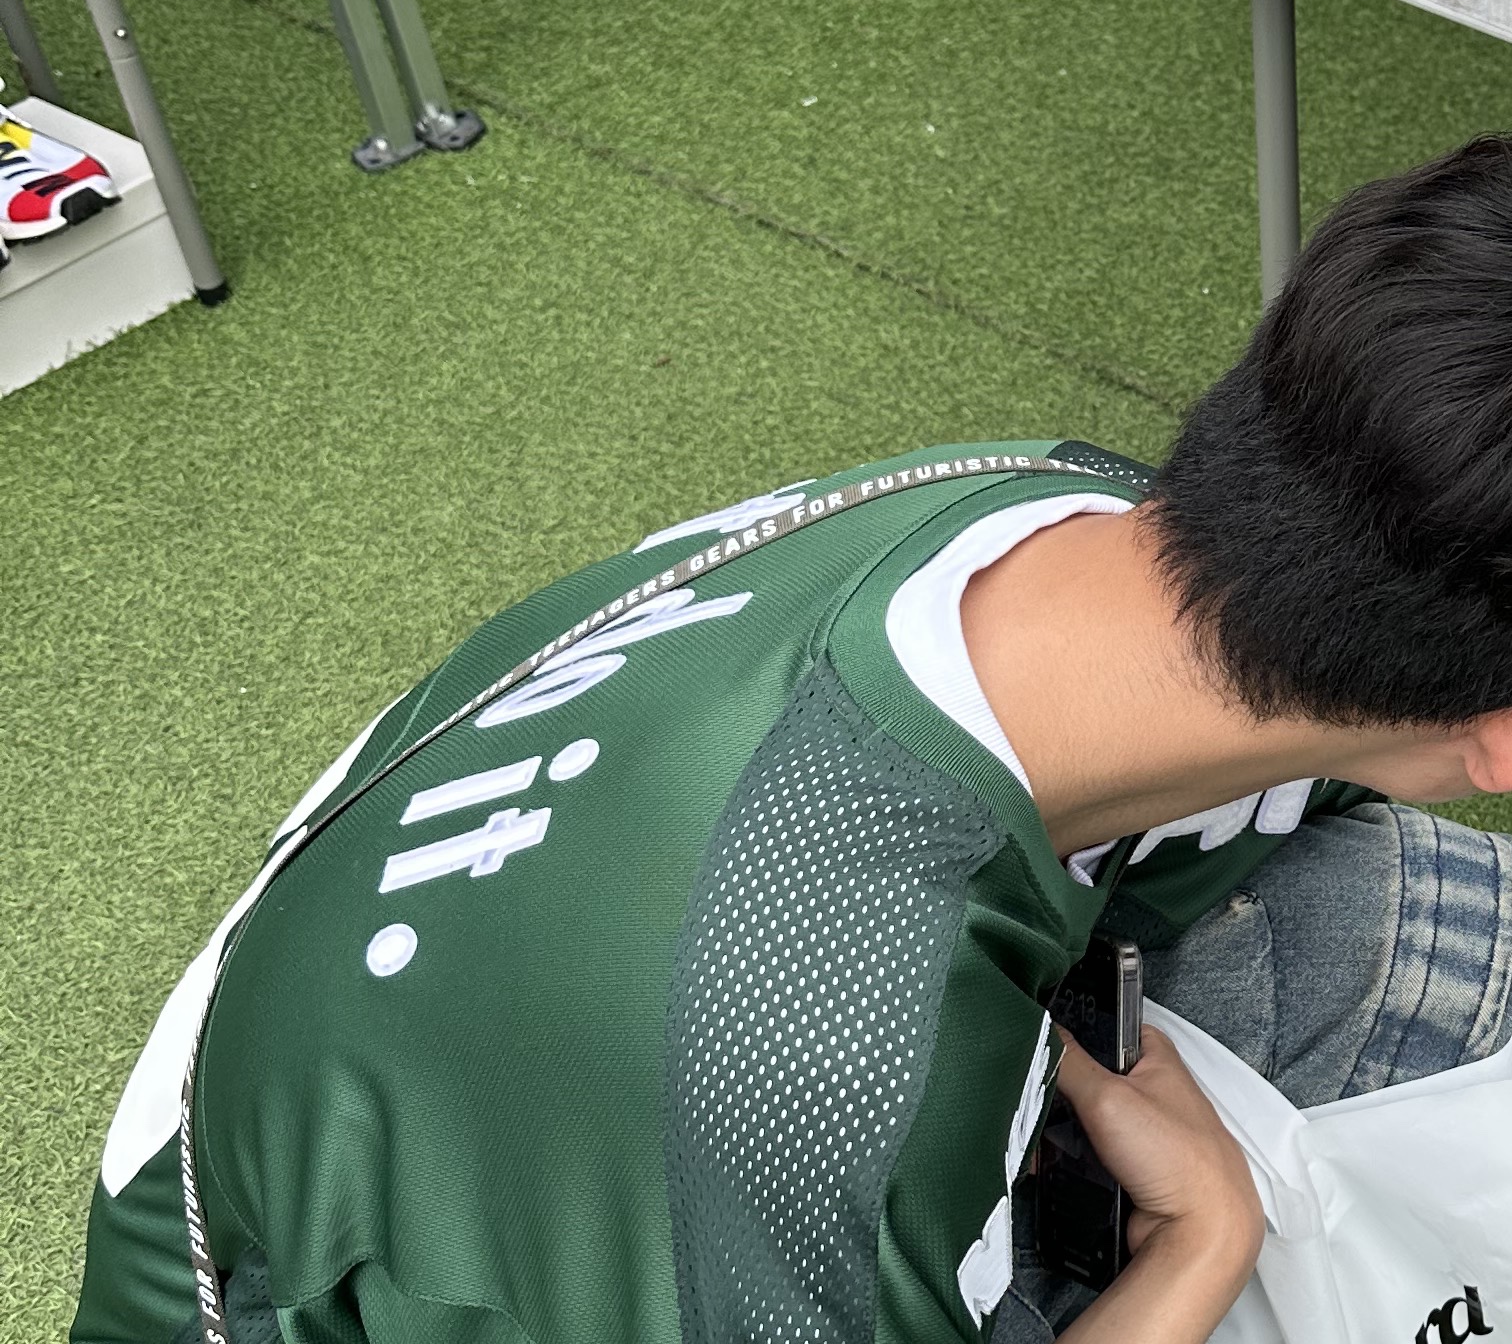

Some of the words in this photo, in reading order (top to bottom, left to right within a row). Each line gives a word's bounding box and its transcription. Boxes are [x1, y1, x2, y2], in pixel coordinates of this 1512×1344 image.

[529, 569, 676, 667] TEENAGERS
[689, 518, 778, 573] GEARS
[792, 491, 845, 527] FOR
[860, 455, 1032, 498] FUTURISTIC
[180, 1098, 210, 1261] FUTURISTIC
[195, 1267, 221, 1322] FOR
